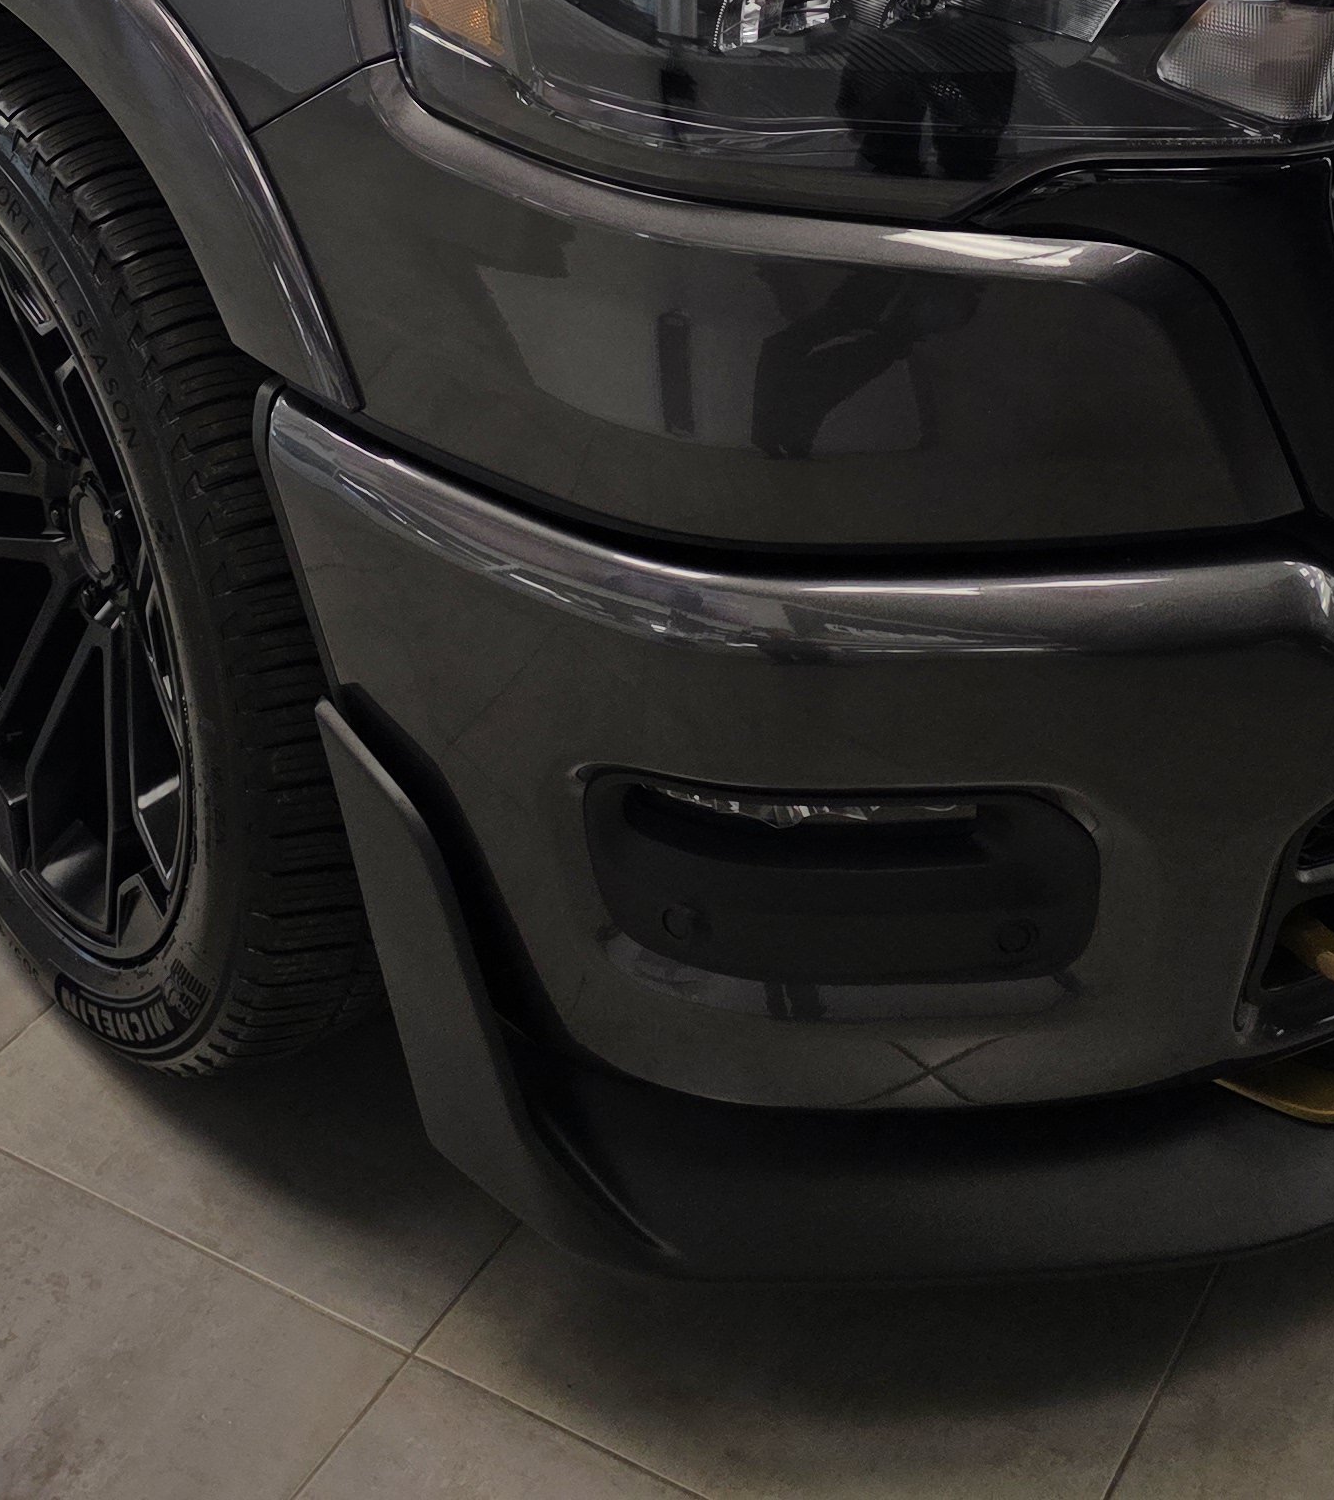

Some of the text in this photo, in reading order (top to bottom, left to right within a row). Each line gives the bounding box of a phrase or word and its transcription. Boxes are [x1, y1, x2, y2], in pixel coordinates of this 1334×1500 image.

[34, 245, 73, 300] ALL
[71, 307, 139, 450] SEASON
[59, 986, 177, 1043] MICHELIN
